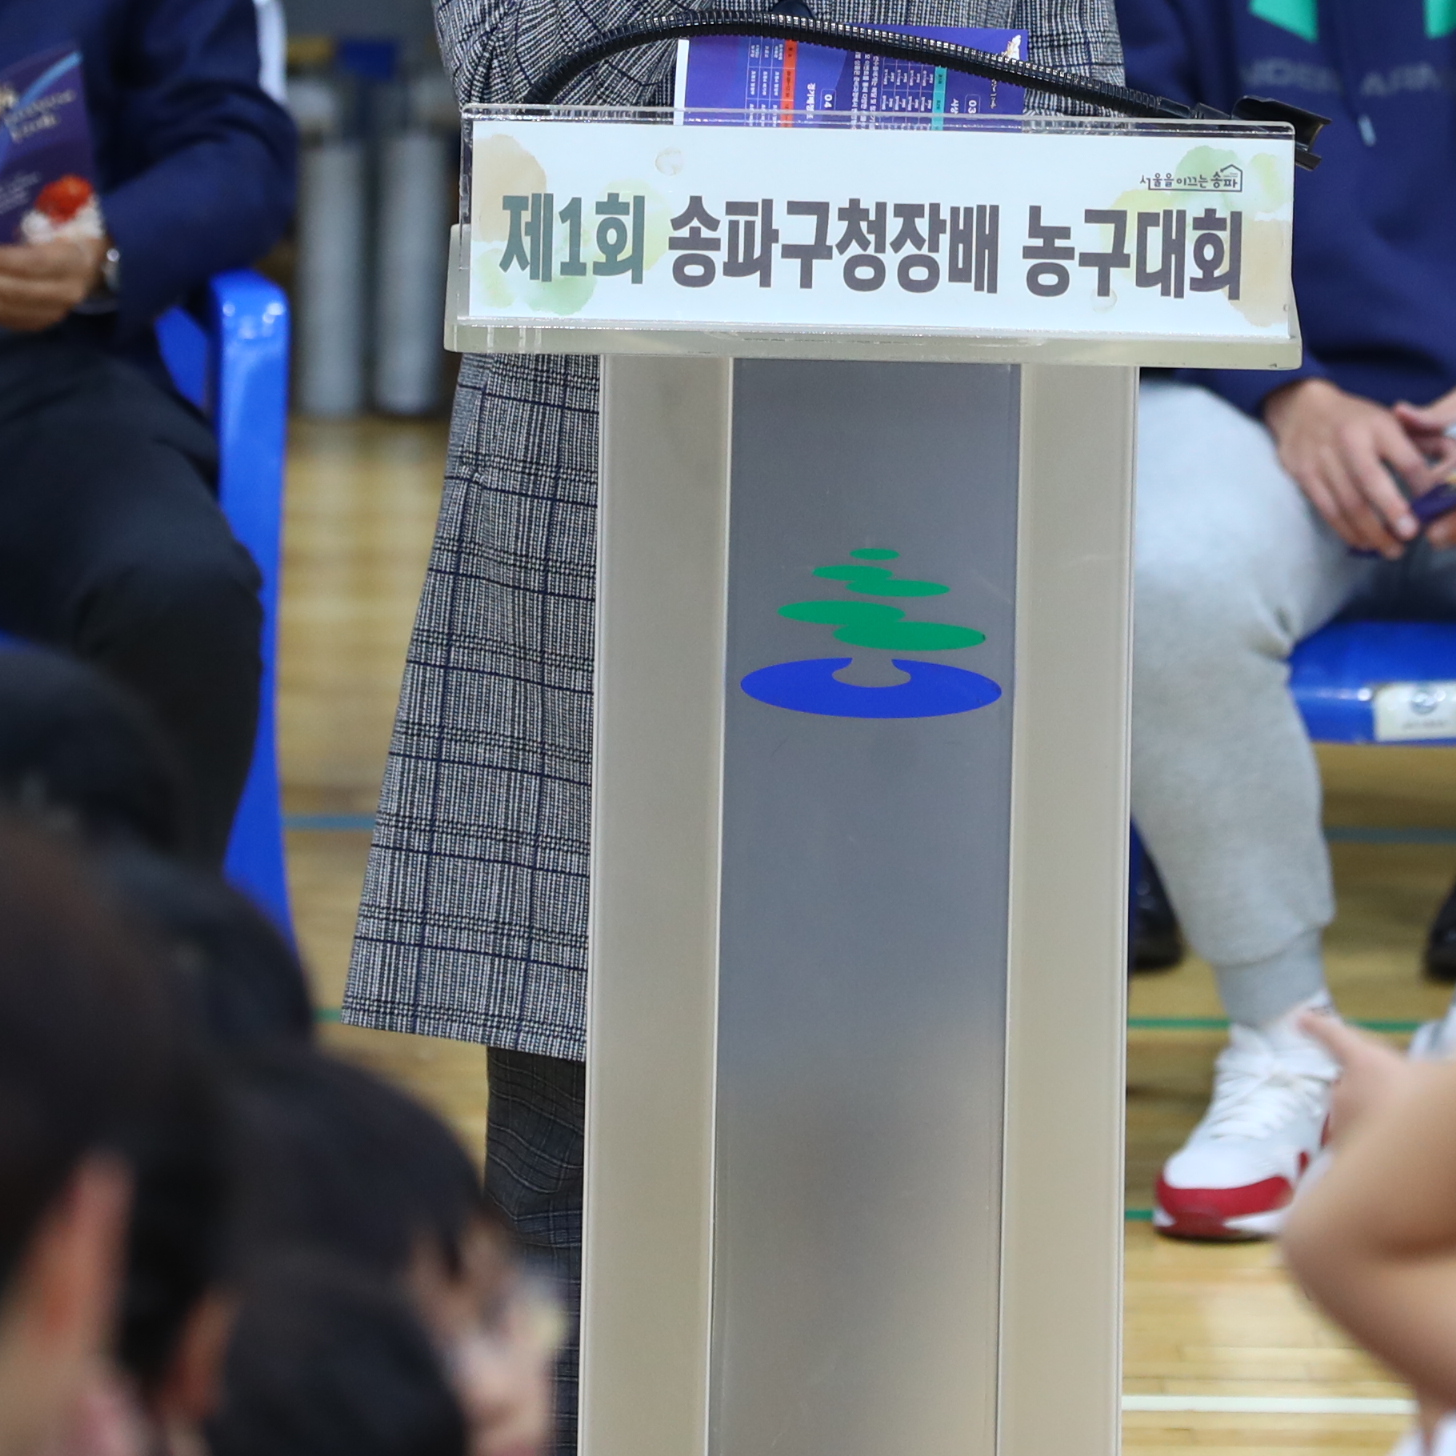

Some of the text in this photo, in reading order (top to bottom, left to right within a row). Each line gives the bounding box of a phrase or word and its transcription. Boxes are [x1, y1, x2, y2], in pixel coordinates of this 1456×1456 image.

[824, 94, 834, 108] 04
[968, 99, 977, 114] 03
[1176, 174, 1208, 189] 이끄는
[1210, 171, 1239, 189] 송파
[499, 193, 1243, 301] 제1회 송파구청장배 농구대회
